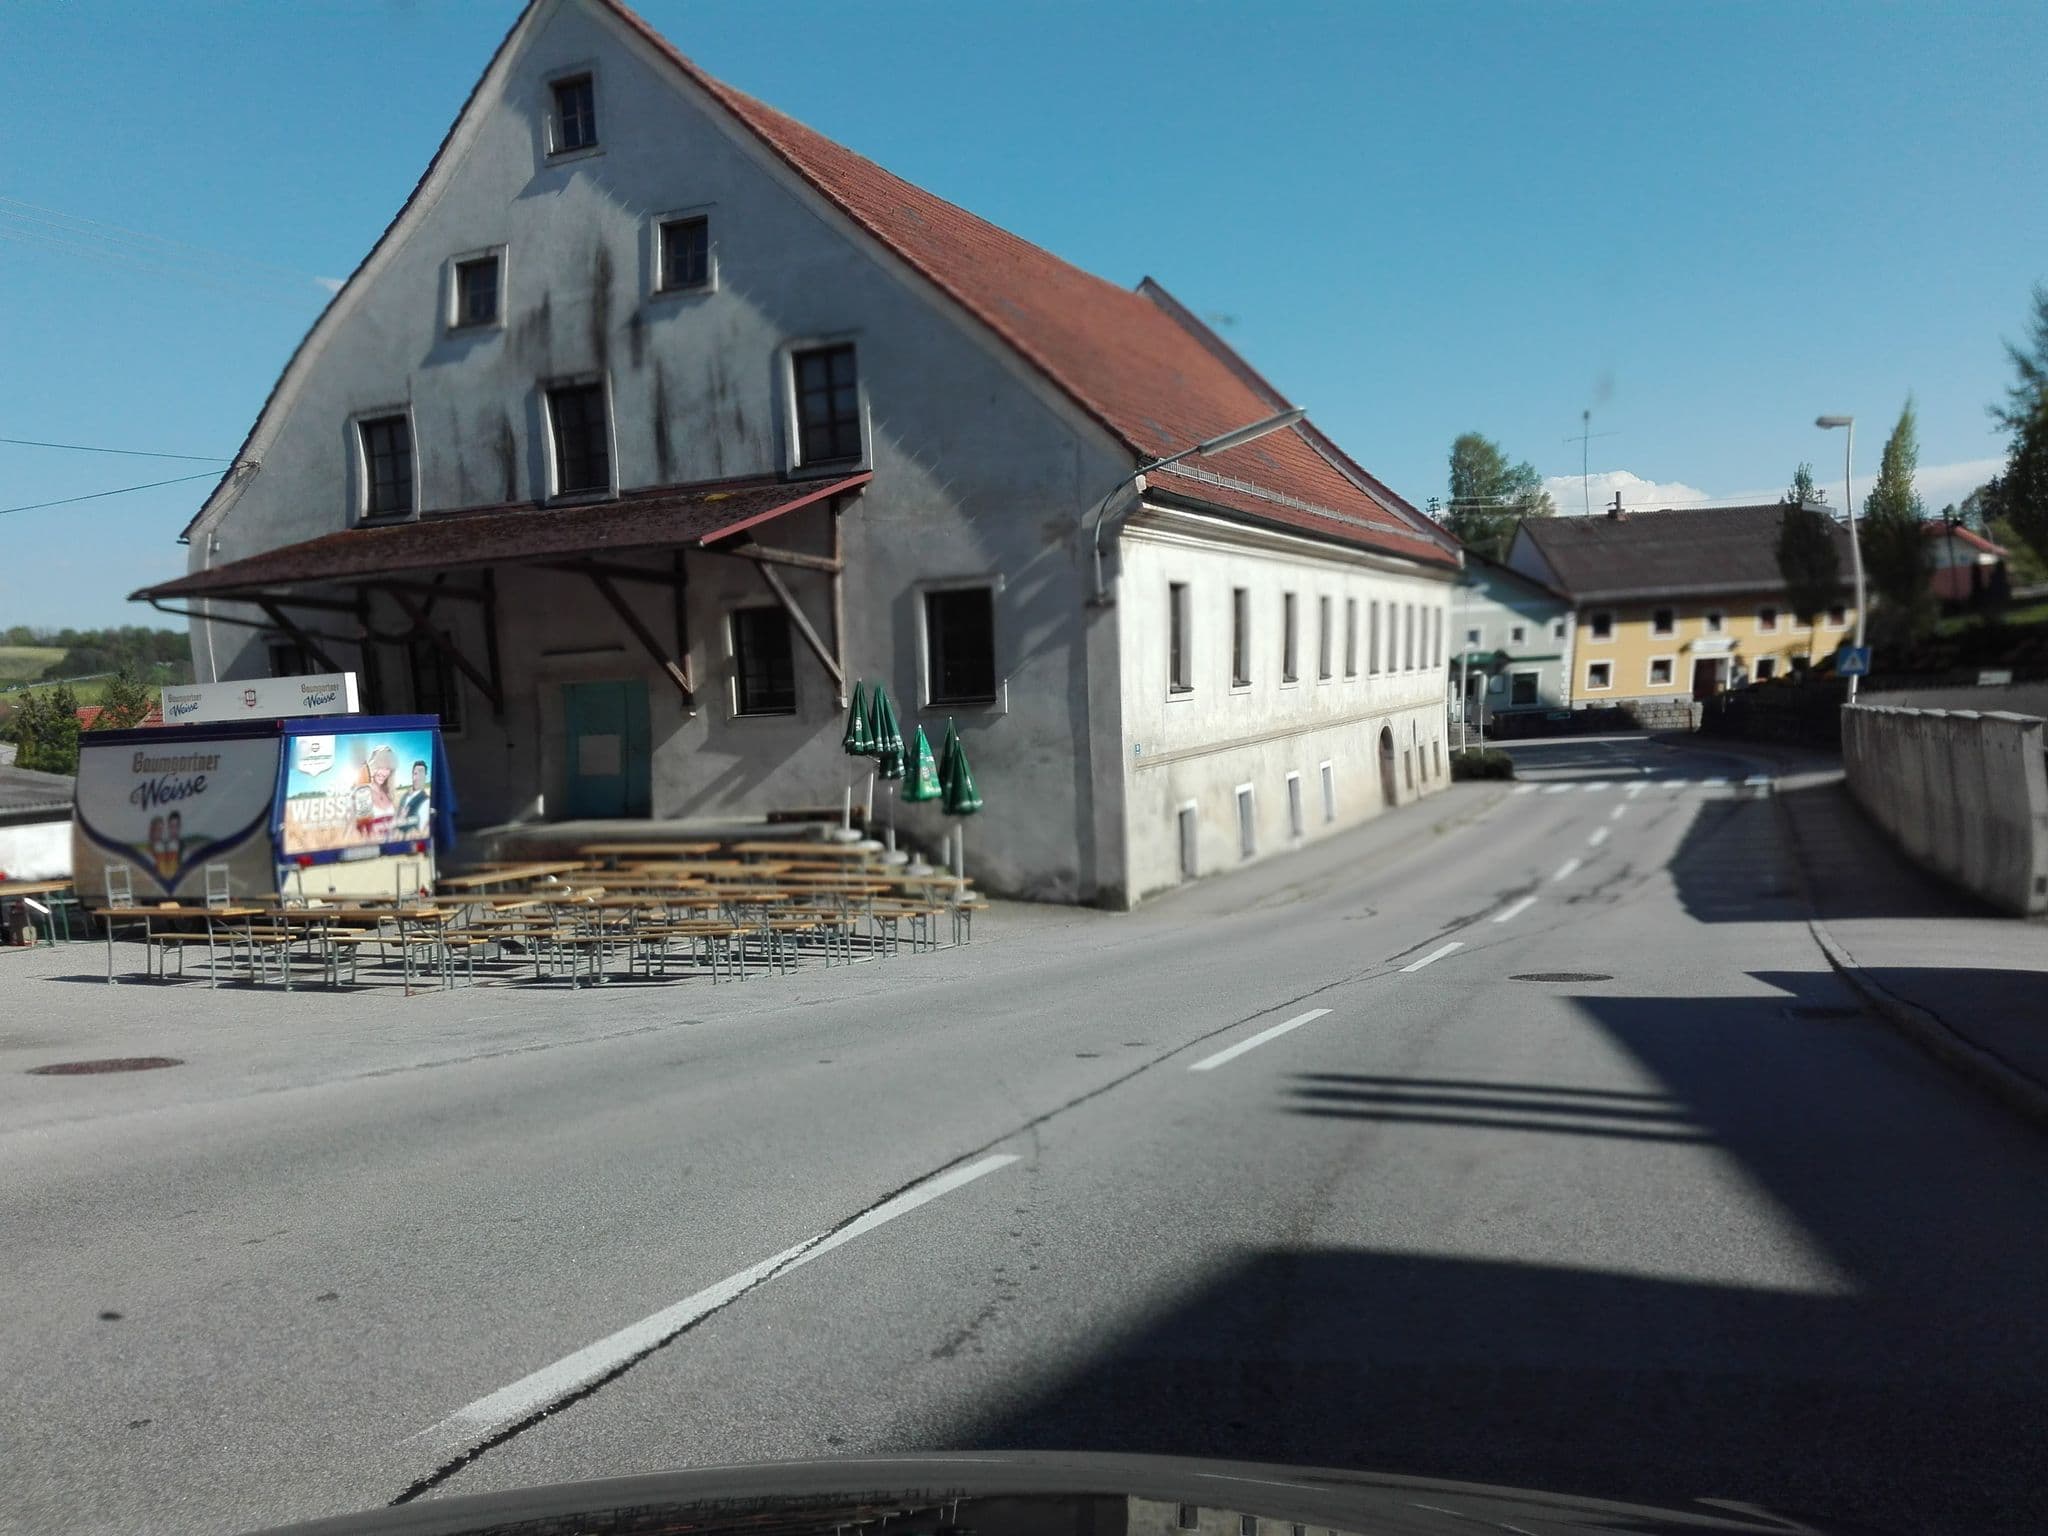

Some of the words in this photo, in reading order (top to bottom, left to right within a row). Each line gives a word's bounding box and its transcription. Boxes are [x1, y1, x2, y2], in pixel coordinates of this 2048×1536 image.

[169, 702, 199, 716] Weisse
[303, 692, 336, 708] Weisse
[132, 751, 221, 775] Baumgartner
[129, 774, 208, 812] Weisse
